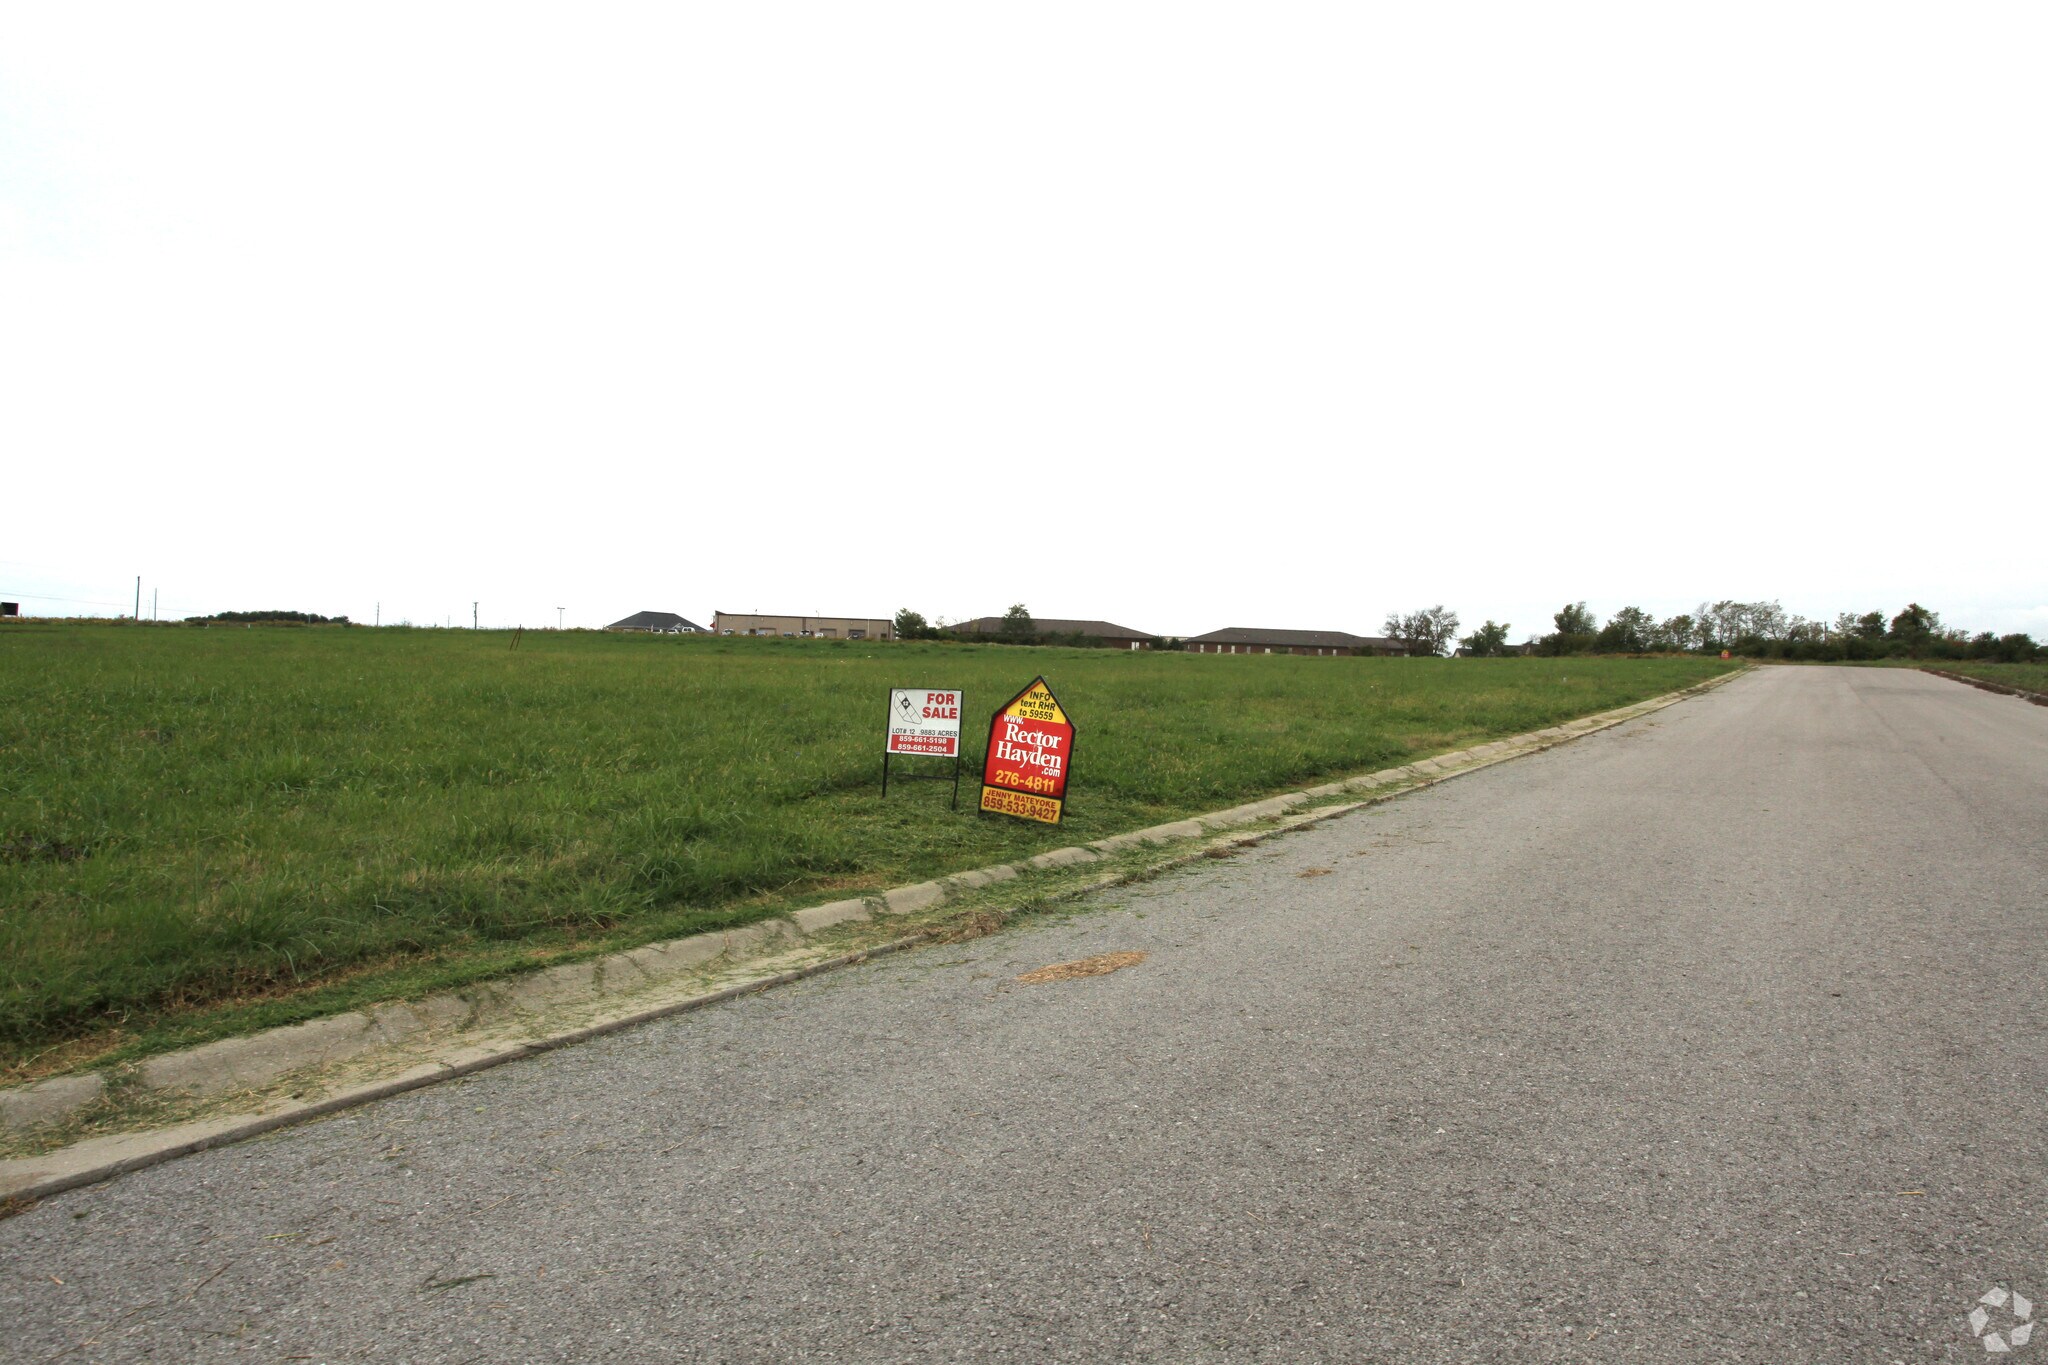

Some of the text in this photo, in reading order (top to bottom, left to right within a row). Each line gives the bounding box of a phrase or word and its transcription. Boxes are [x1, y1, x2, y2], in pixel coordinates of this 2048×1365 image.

[927, 693, 955, 705] FOR
[1029, 691, 1051, 701] INFO
[1020, 699, 1056, 711] text RHR
[922, 707, 958, 719] SALE
[1019, 708, 1054, 720] to 59559
[1004, 723, 1062, 749] Rector
[996, 741, 1062, 769] Hayden
[1041, 767, 1060, 777] .com
[995, 769, 1055, 793] 276-4811
[986, 789, 1056, 808] JENNY MATEYOKE
